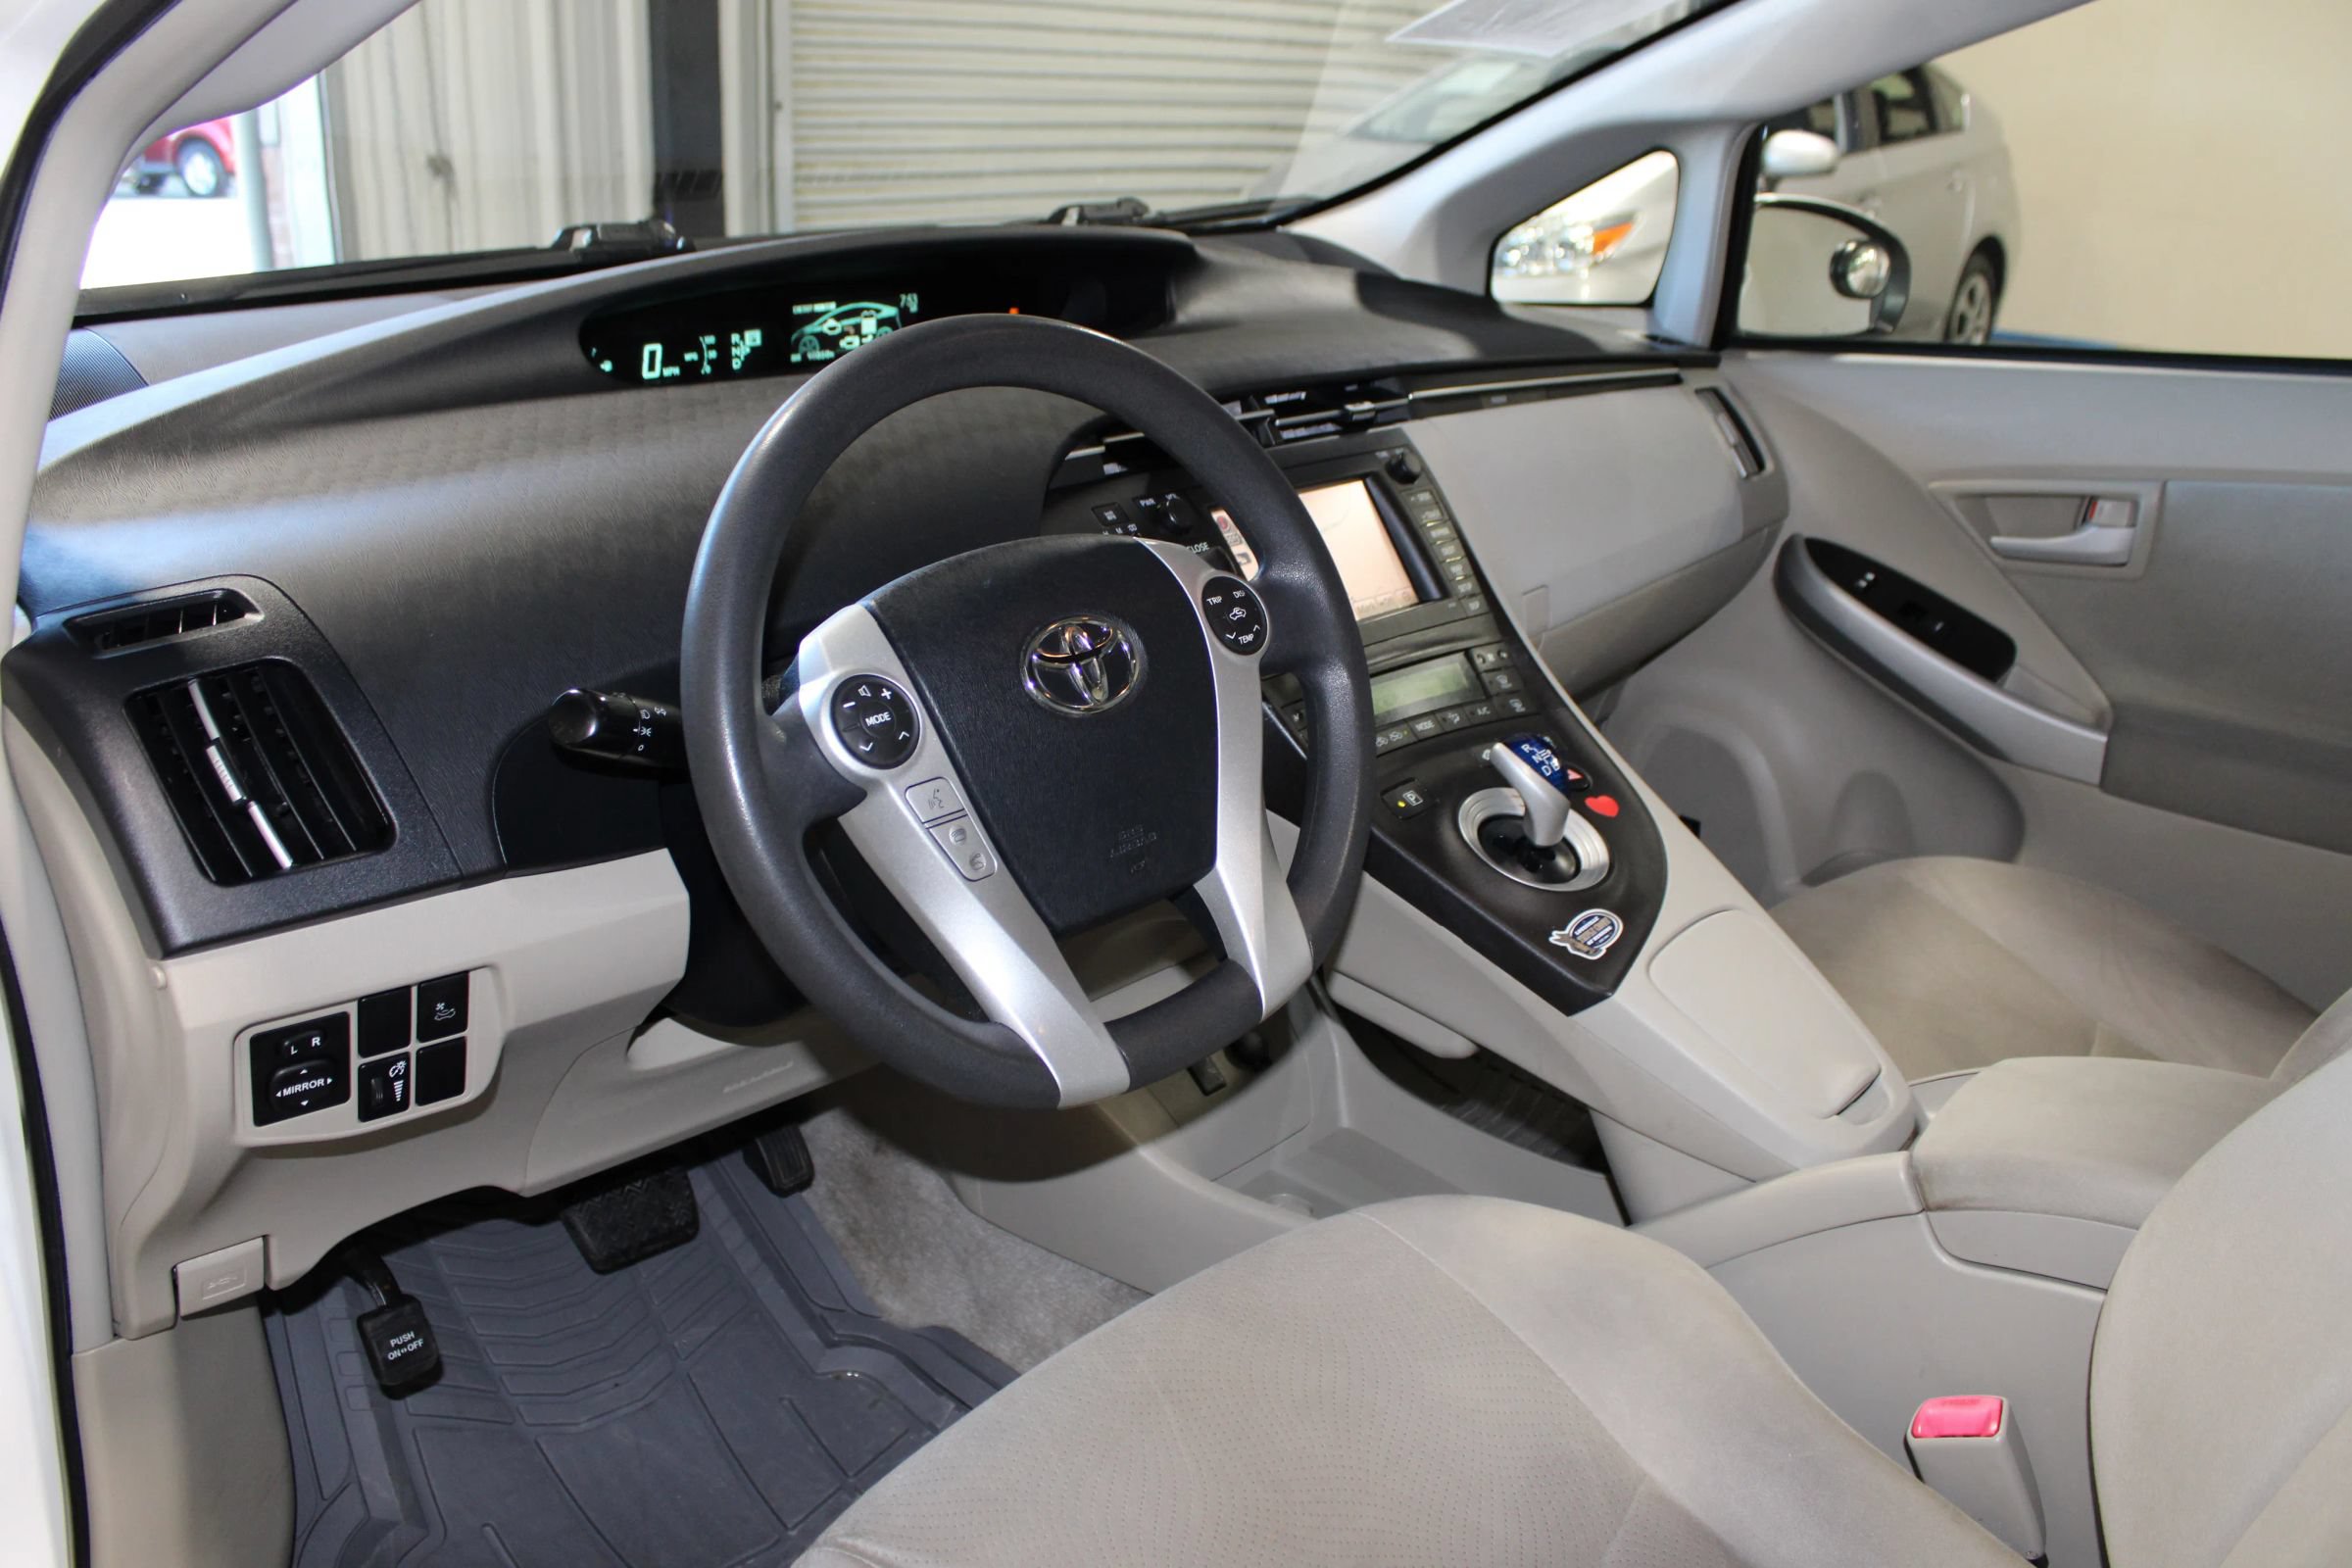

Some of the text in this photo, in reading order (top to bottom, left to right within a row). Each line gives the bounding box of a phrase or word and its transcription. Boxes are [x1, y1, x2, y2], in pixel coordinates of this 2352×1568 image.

[642, 342, 663, 380] 0
[1206, 595, 1223, 606] TRIP
[1233, 590, 1246, 599] DIS
[1238, 633, 1254, 645] TEMP
[864, 711, 892, 726] MODE
[1520, 743, 1532, 754] R
[1541, 764, 1552, 777] D
[312, 1036, 321, 1048] R
[290, 1045, 299, 1055] L
[282, 1077, 325, 1097] MIRROR
[389, 1330, 416, 1348] PUSH
[387, 1338, 424, 1360] ON OFF
